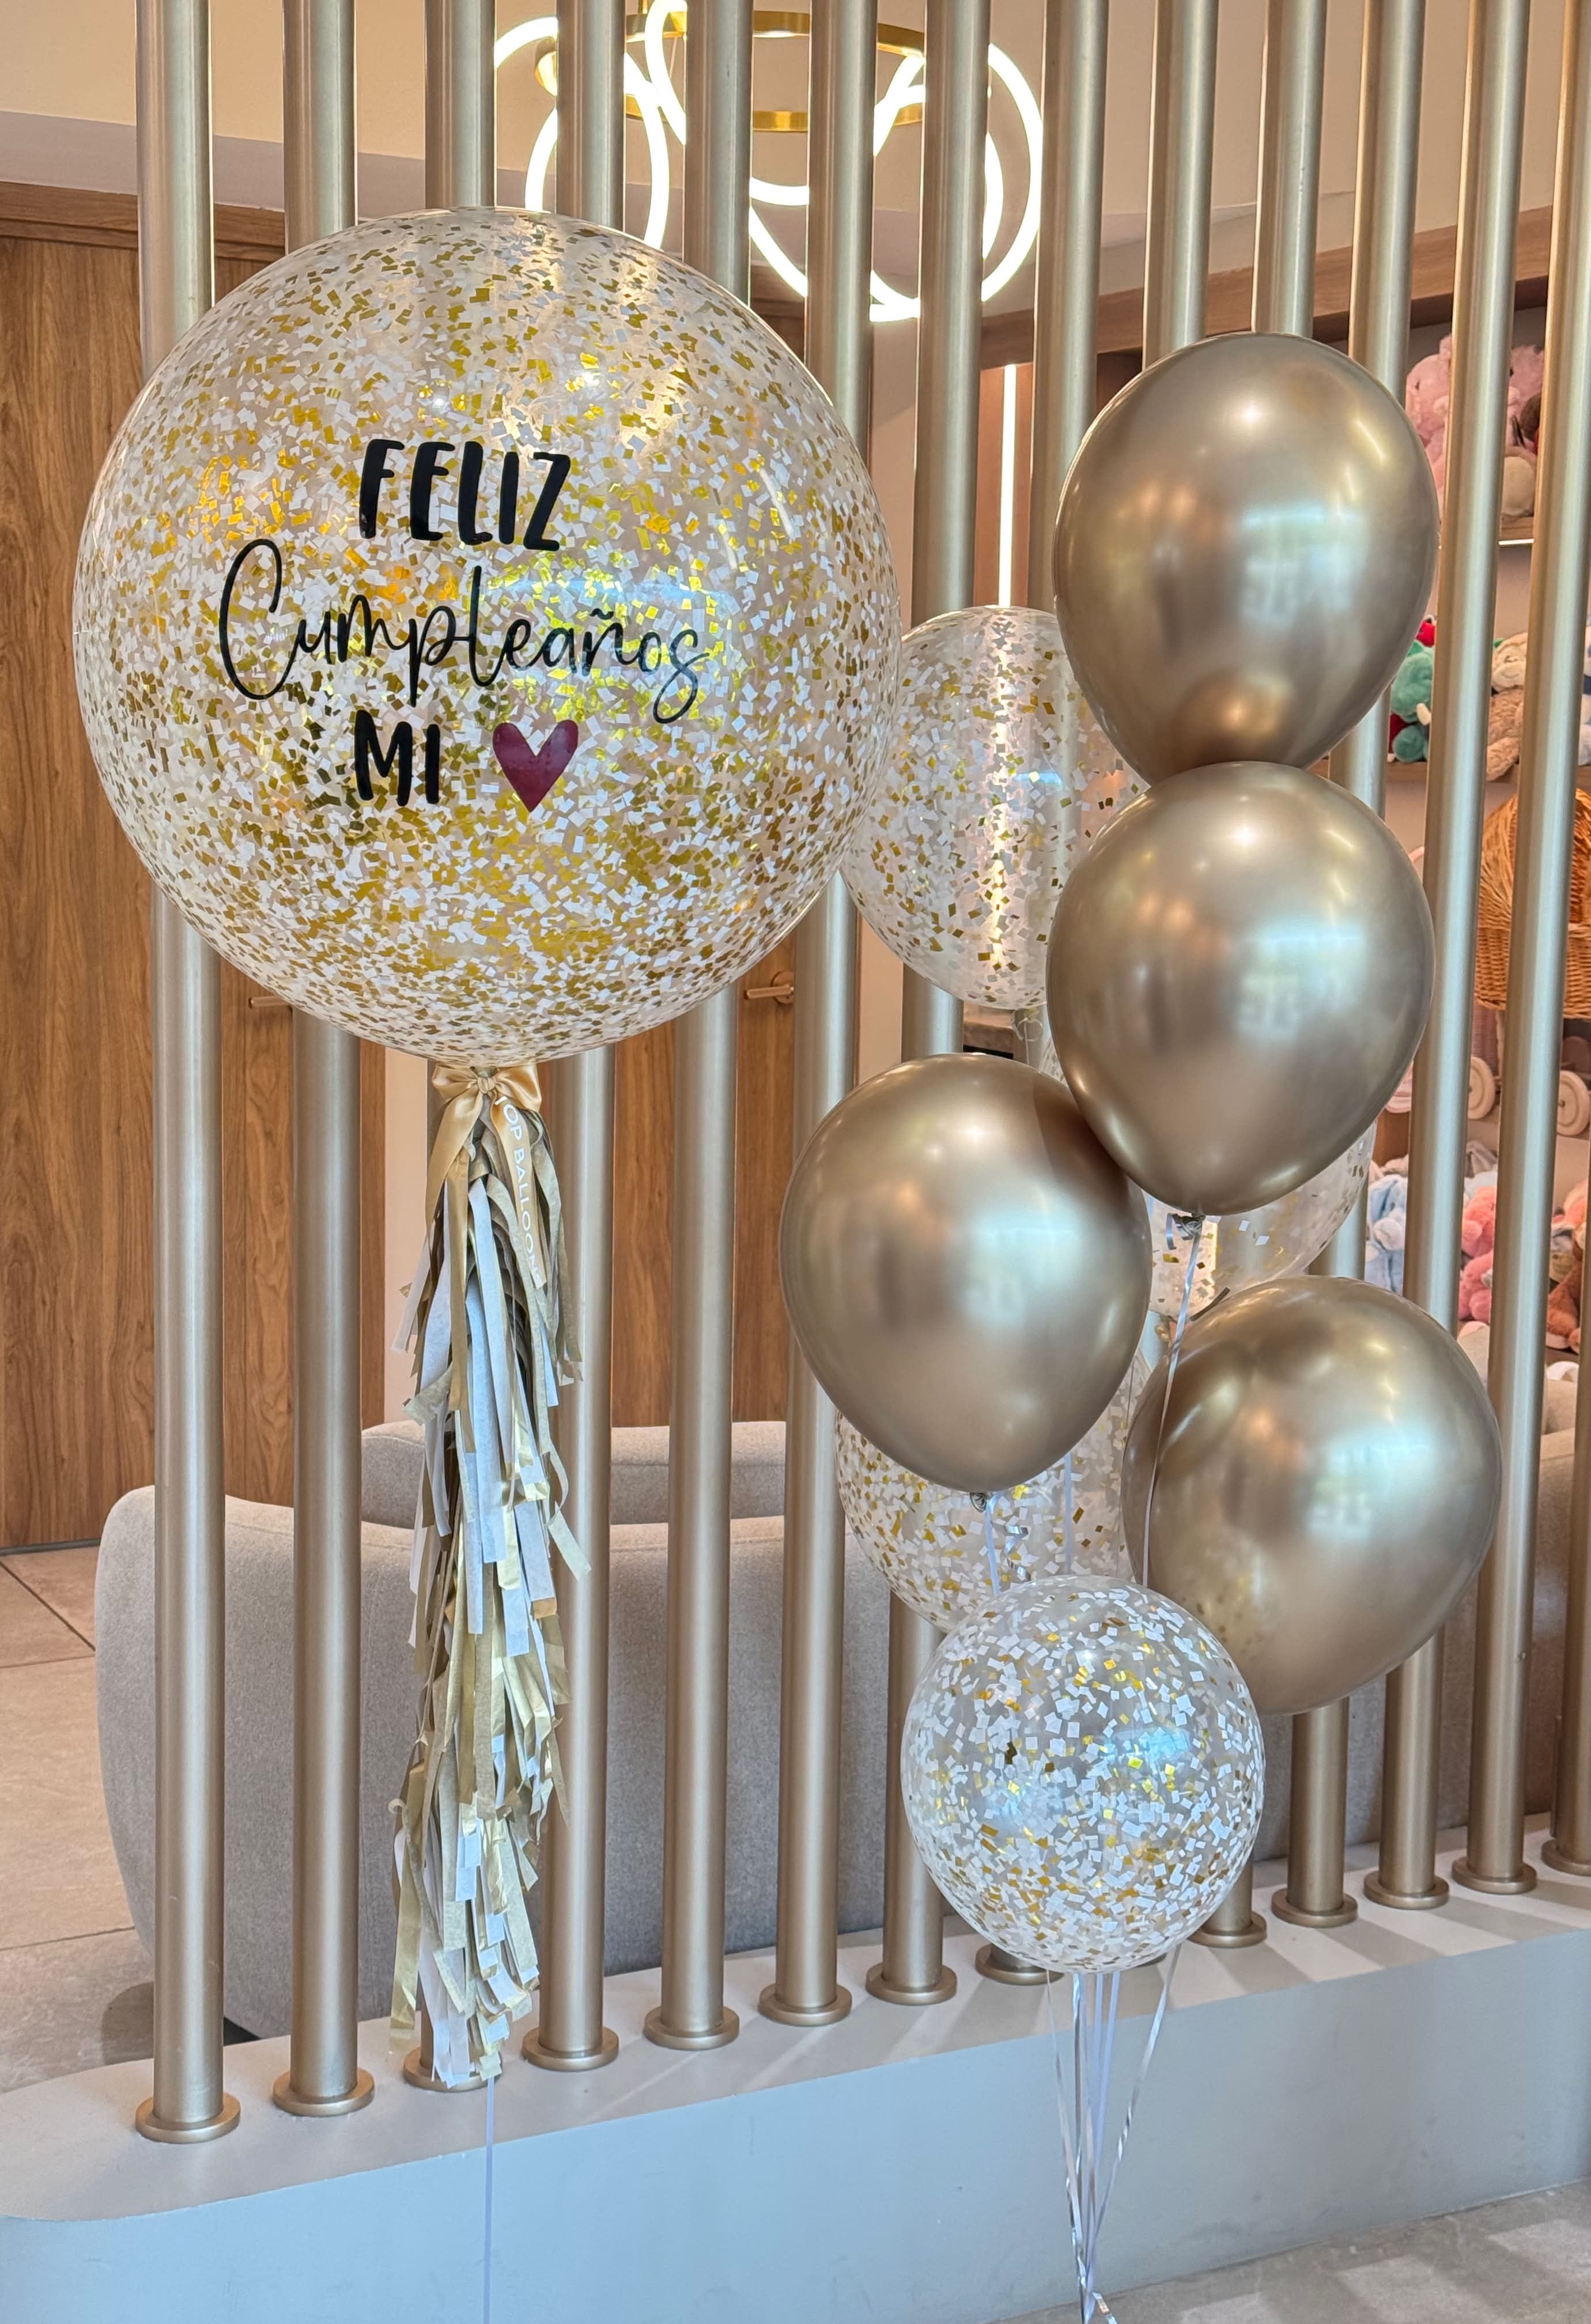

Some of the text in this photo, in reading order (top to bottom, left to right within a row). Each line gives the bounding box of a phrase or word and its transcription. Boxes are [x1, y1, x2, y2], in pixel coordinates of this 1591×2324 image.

[359, 439, 571, 552] FELIZ
[219, 538, 710, 724] Cumpleaños
[354, 710, 439, 806] MI
